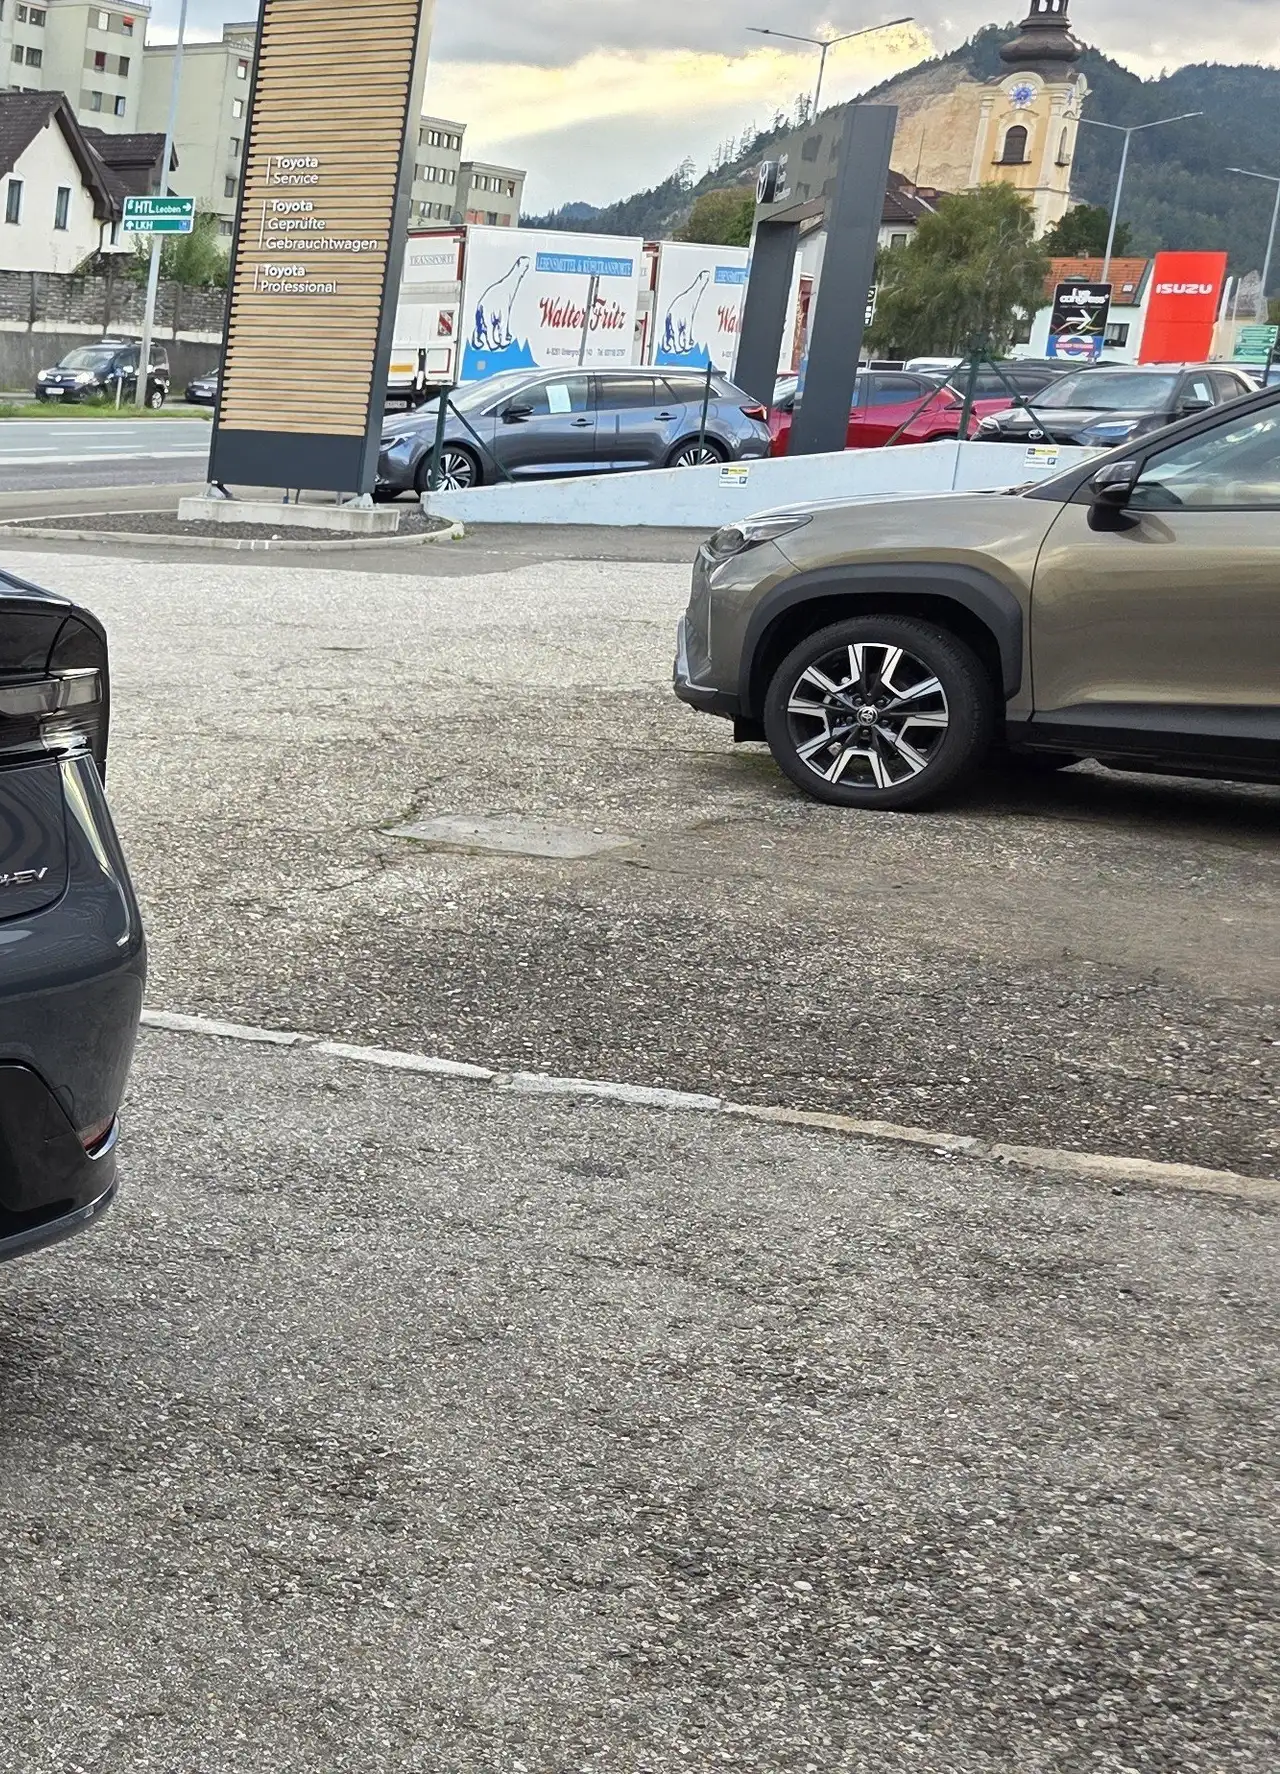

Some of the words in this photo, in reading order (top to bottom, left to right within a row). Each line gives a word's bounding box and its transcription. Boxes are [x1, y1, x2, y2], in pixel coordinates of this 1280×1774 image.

[276, 156, 318, 170] Toyota
[273, 172, 318, 184] Service
[135, 201, 155, 213] HTL
[156, 205, 181, 214] Leoben
[271, 200, 313, 214] Toyota
[135, 221, 154, 230] LKH
[268, 217, 325, 231] Geprüfte
[266, 237, 378, 252] Gebrauchtwagen
[264, 264, 306, 278] Toyota
[260, 280, 337, 294] Professional
[1155, 283, 1213, 294] ISUZU
[539, 297, 588, 329] Walter
[590, 296, 627, 331] Fritz
